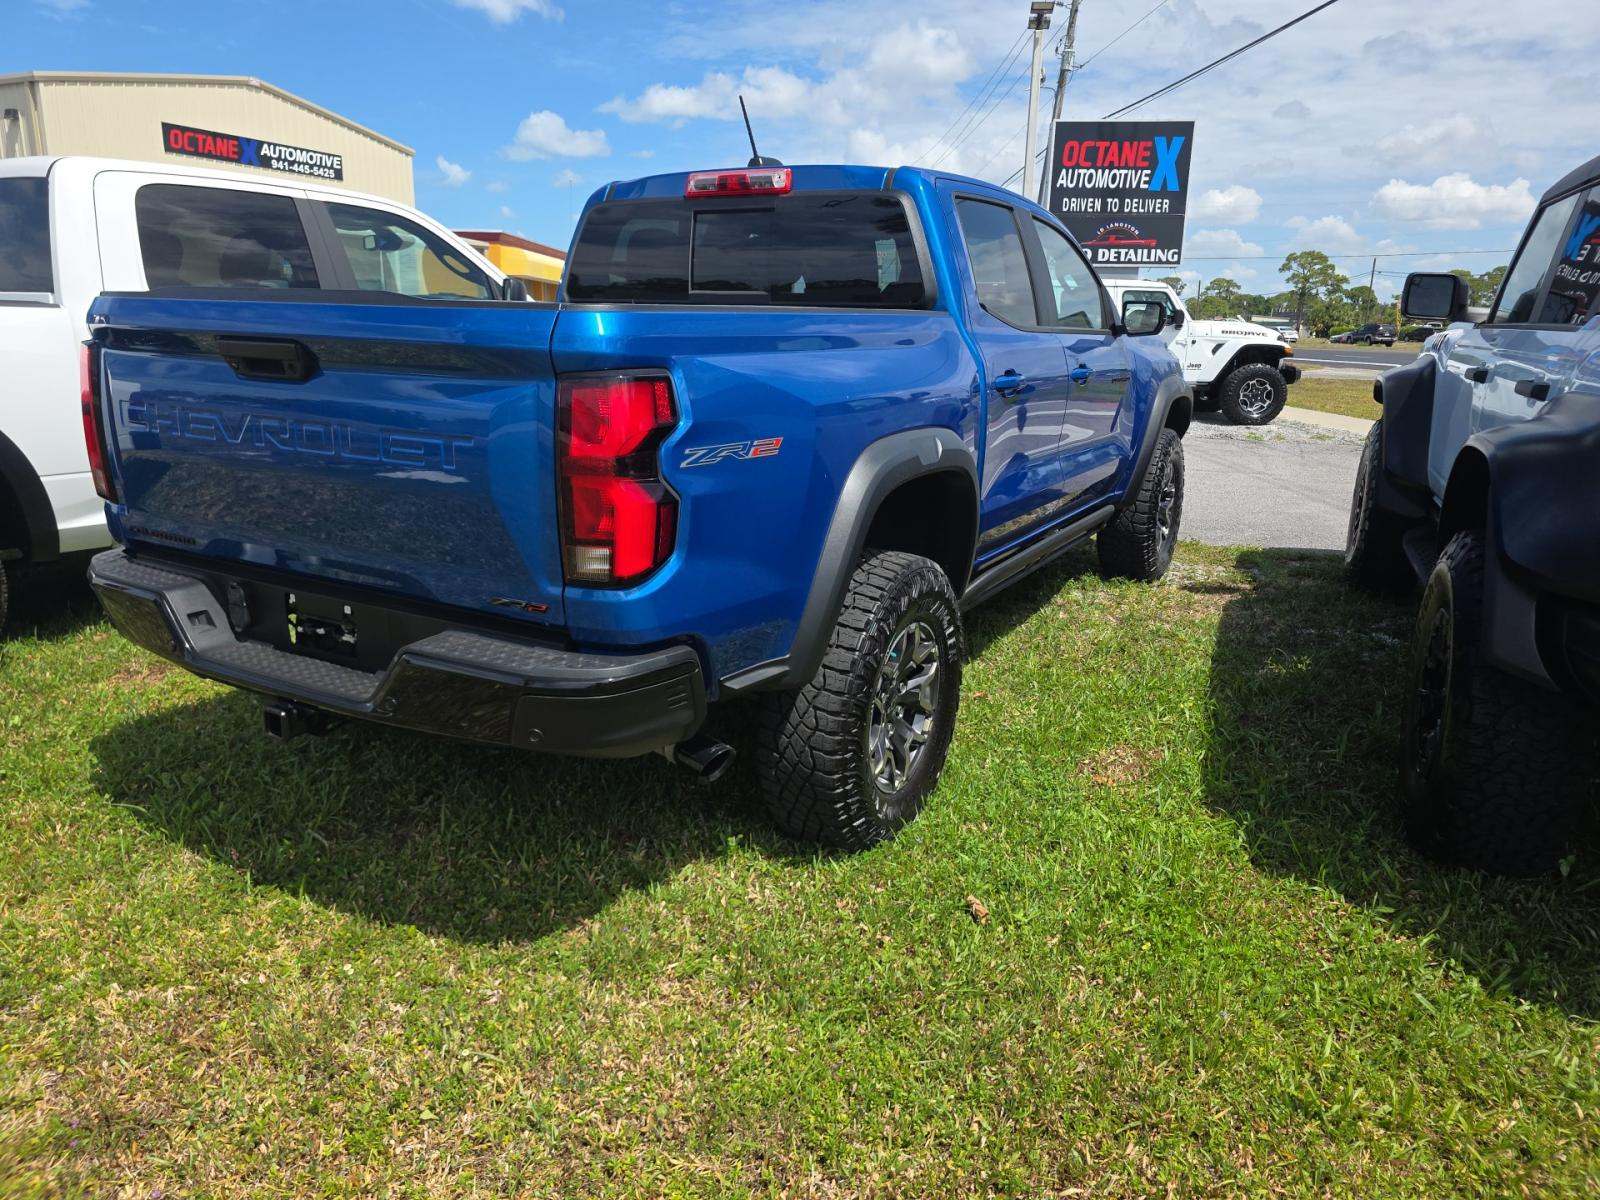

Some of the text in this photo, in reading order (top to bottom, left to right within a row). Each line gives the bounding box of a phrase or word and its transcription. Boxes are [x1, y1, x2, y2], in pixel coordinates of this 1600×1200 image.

[169, 129, 262, 167] OCTANE X
[261, 143, 342, 169] AUTOMOTIVE
[271, 160, 335, 179] 941-445-5425
[1062, 136, 1185, 192] OCTANE X
[1057, 168, 1152, 189] AUTOMOTIVE
[1062, 198, 1170, 213] DRIVEN TO DELIVER
[1098, 248, 1179, 262] DETAILING
[119, 399, 474, 470] CHEVROLET
[680, 437, 784, 468] ZR2
